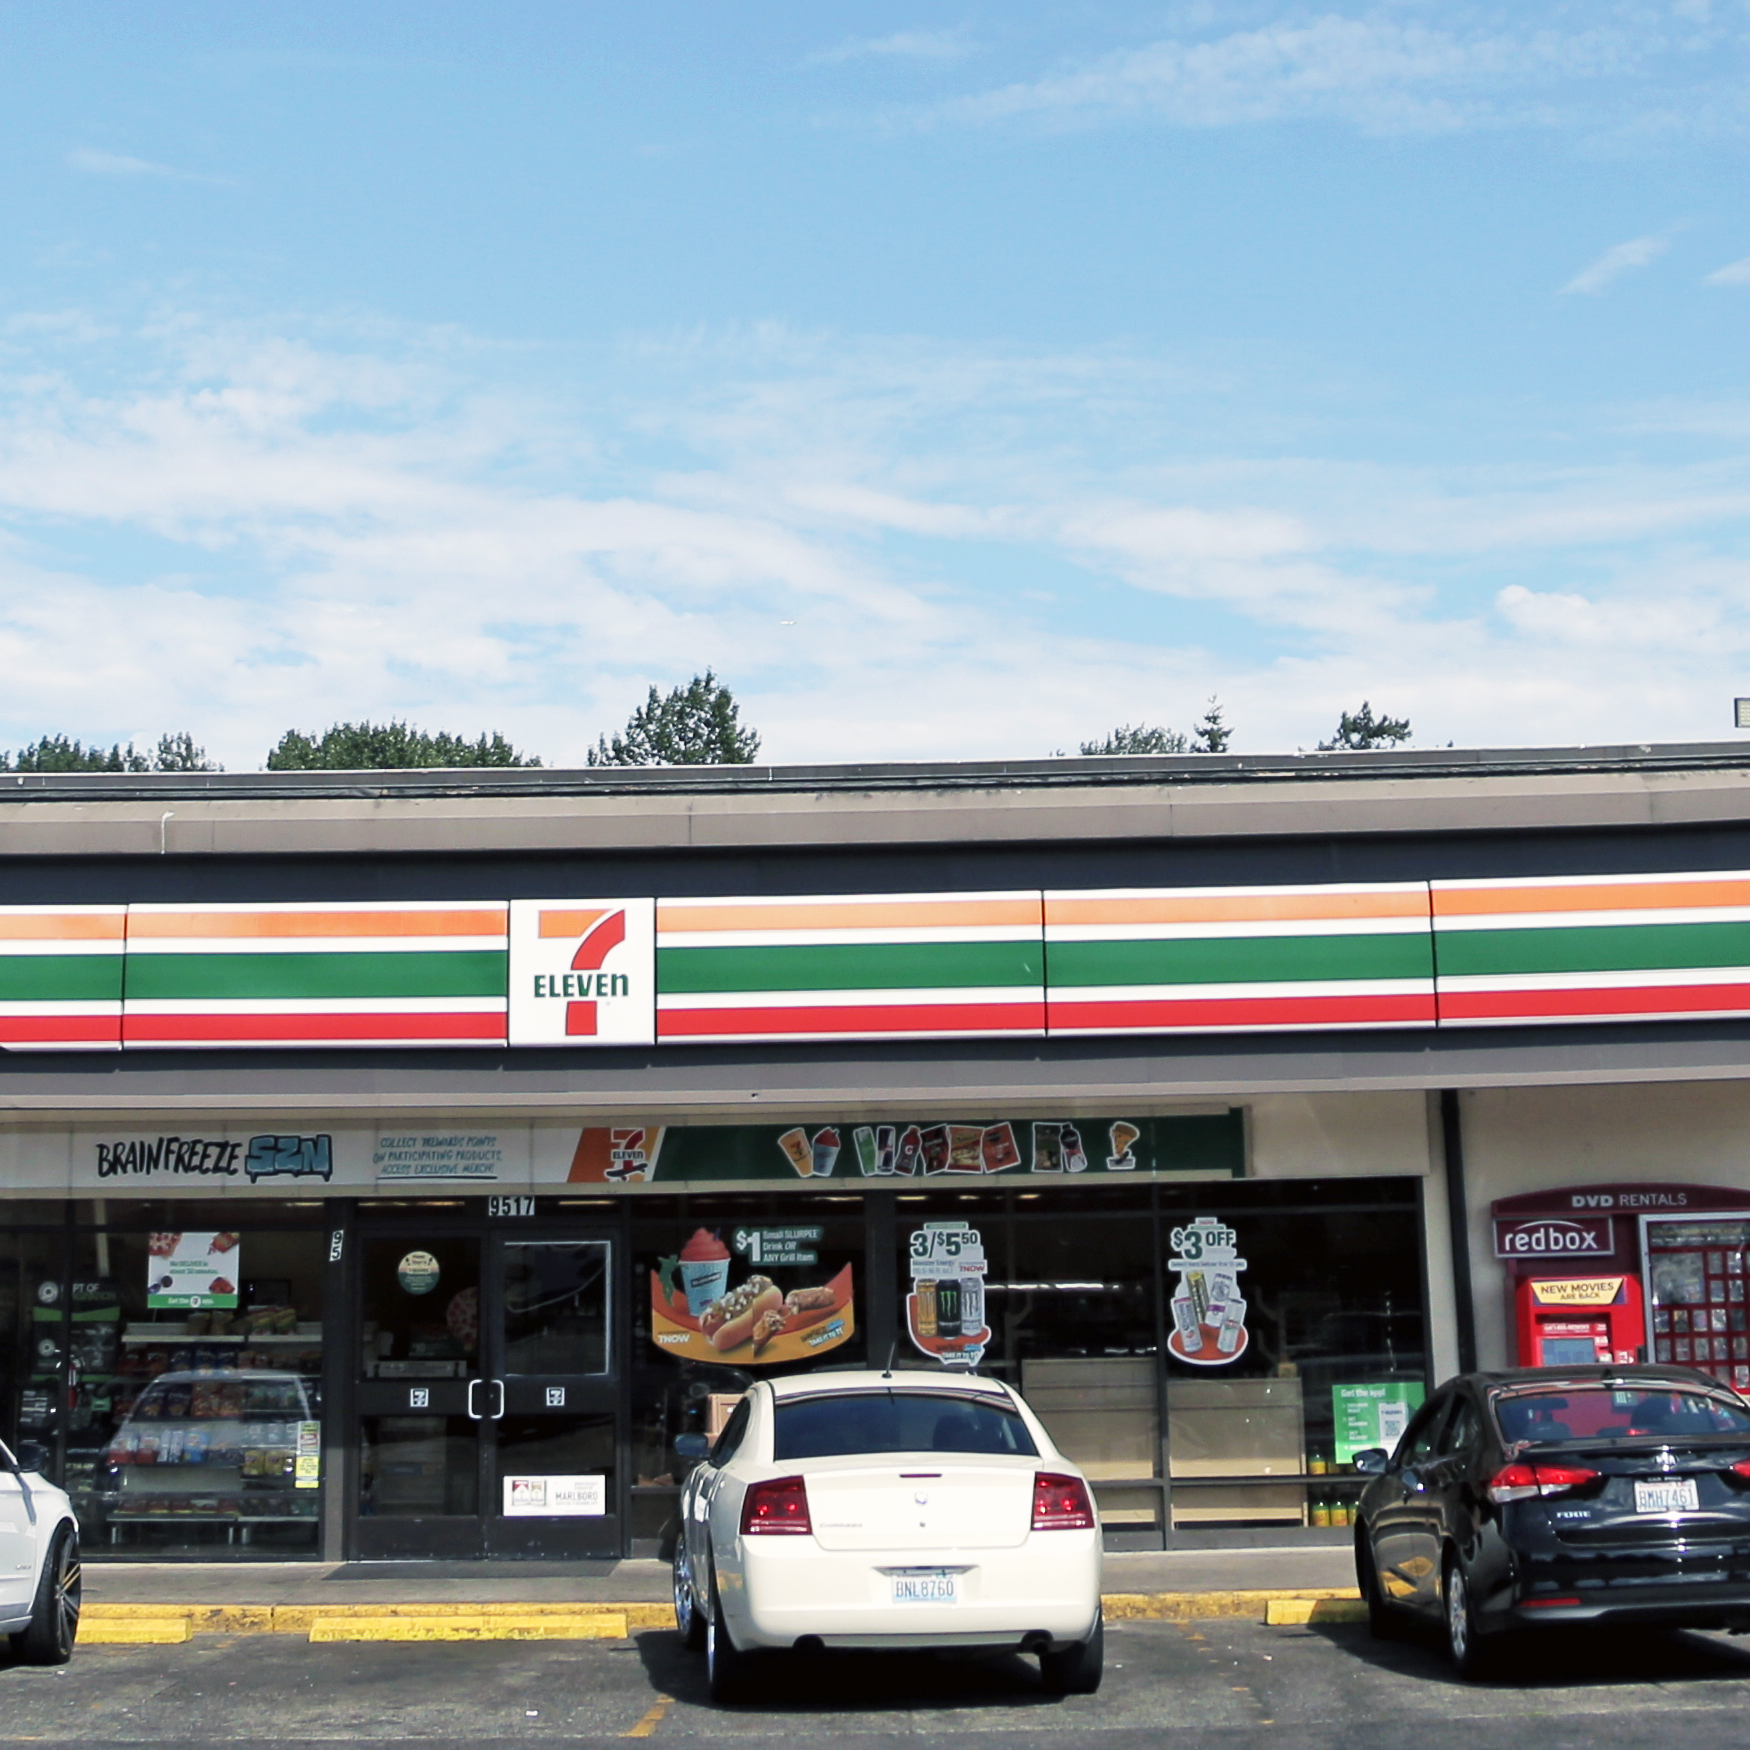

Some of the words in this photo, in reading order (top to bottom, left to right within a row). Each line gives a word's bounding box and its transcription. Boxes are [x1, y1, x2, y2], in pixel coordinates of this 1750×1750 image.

[538, 908, 626, 1037] 7
[380, 1136, 418, 1148] COLLECT
[372, 1152, 387, 1164] ON
[388, 1150, 453, 1162] PARTICIPATING
[380, 1164, 411, 1174] ACCESS
[414, 1164, 458, 1174] EXCLUSIVE
[489, 1197, 535, 1216] 9517
[1571, 1195, 1615, 1207] DVD
[1619, 1193, 1687, 1207] RENTALS
[762, 1241, 783, 1250] Drink
[784, 1241, 797, 1250] OR
[1173, 1229, 1203, 1260] $3
[1205, 1231, 1234, 1246] OFF
[1504, 1226, 1598, 1251] redbox
[736, 1230, 761, 1262] $1
[762, 1230, 783, 1239] Small
[763, 1253, 779, 1262] ANY
[780, 1253, 795, 1262] Grill
[1540, 1284, 1569, 1294] NEW
[1570, 1282, 1615, 1293] MOVIES
[1578, 1292, 1601, 1300] BACK
[1341, 1389, 1355, 1397] Get
[1356, 1388, 1369, 1397] the
[555, 1491, 598, 1501] MARLBORO
[1639, 1487, 1698, 1509] BMH7461
[896, 1579, 954, 1598] BNL8760
